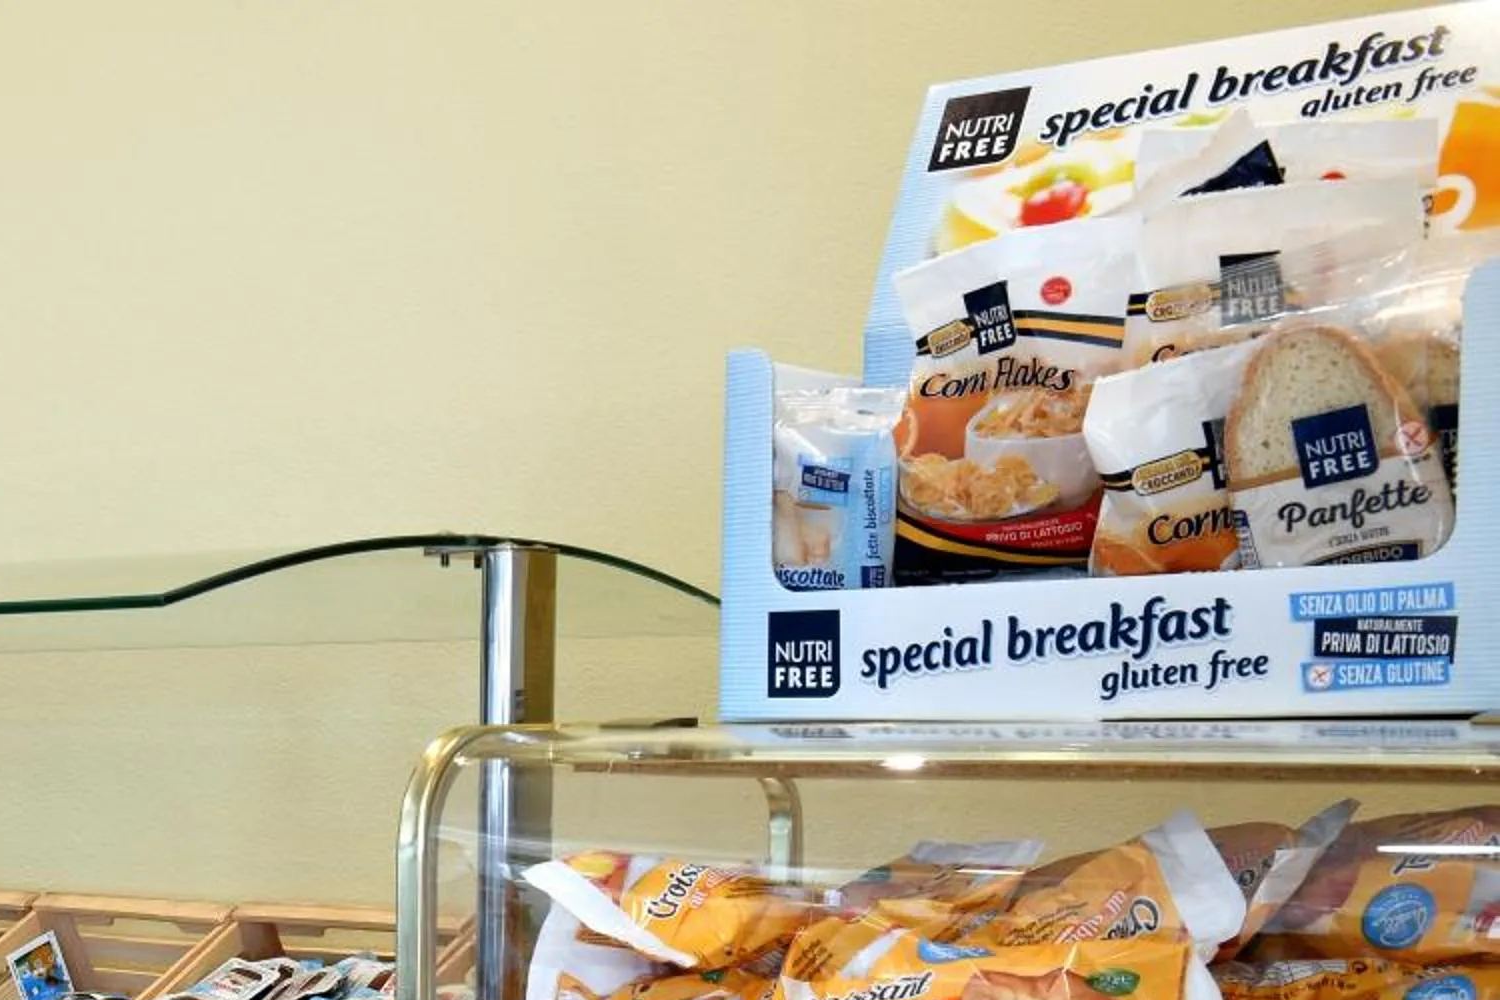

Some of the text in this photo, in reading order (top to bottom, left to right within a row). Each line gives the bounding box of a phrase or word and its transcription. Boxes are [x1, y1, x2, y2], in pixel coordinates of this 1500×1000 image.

[1040, 25, 1451, 147] special breakfast
[1300, 66, 1477, 118] gluten free
[945, 112, 1015, 141] NUTRI
[938, 135, 1008, 164] FREE
[973, 304, 1009, 329] NUTRI
[1228, 295, 1280, 318] FREE
[979, 322, 1014, 347] FREE
[919, 356, 1075, 398] Corn Flakes
[1304, 428, 1366, 460] NUTRI
[1308, 450, 1372, 480] FREE
[1277, 479, 1433, 532] Panfette
[1147, 506, 1233, 545] Corn
[1299, 586, 1448, 616] SENZA OLIO DI PALMA
[774, 640, 833, 663] NUTRI
[860, 595, 1232, 690] special breakfast
[1321, 632, 1450, 656] PRIVA DI LATTOSIO
[774, 666, 834, 689] FREE
[1099, 649, 1269, 701] gluten free
[1338, 660, 1445, 685] SENZA GLUTINE
